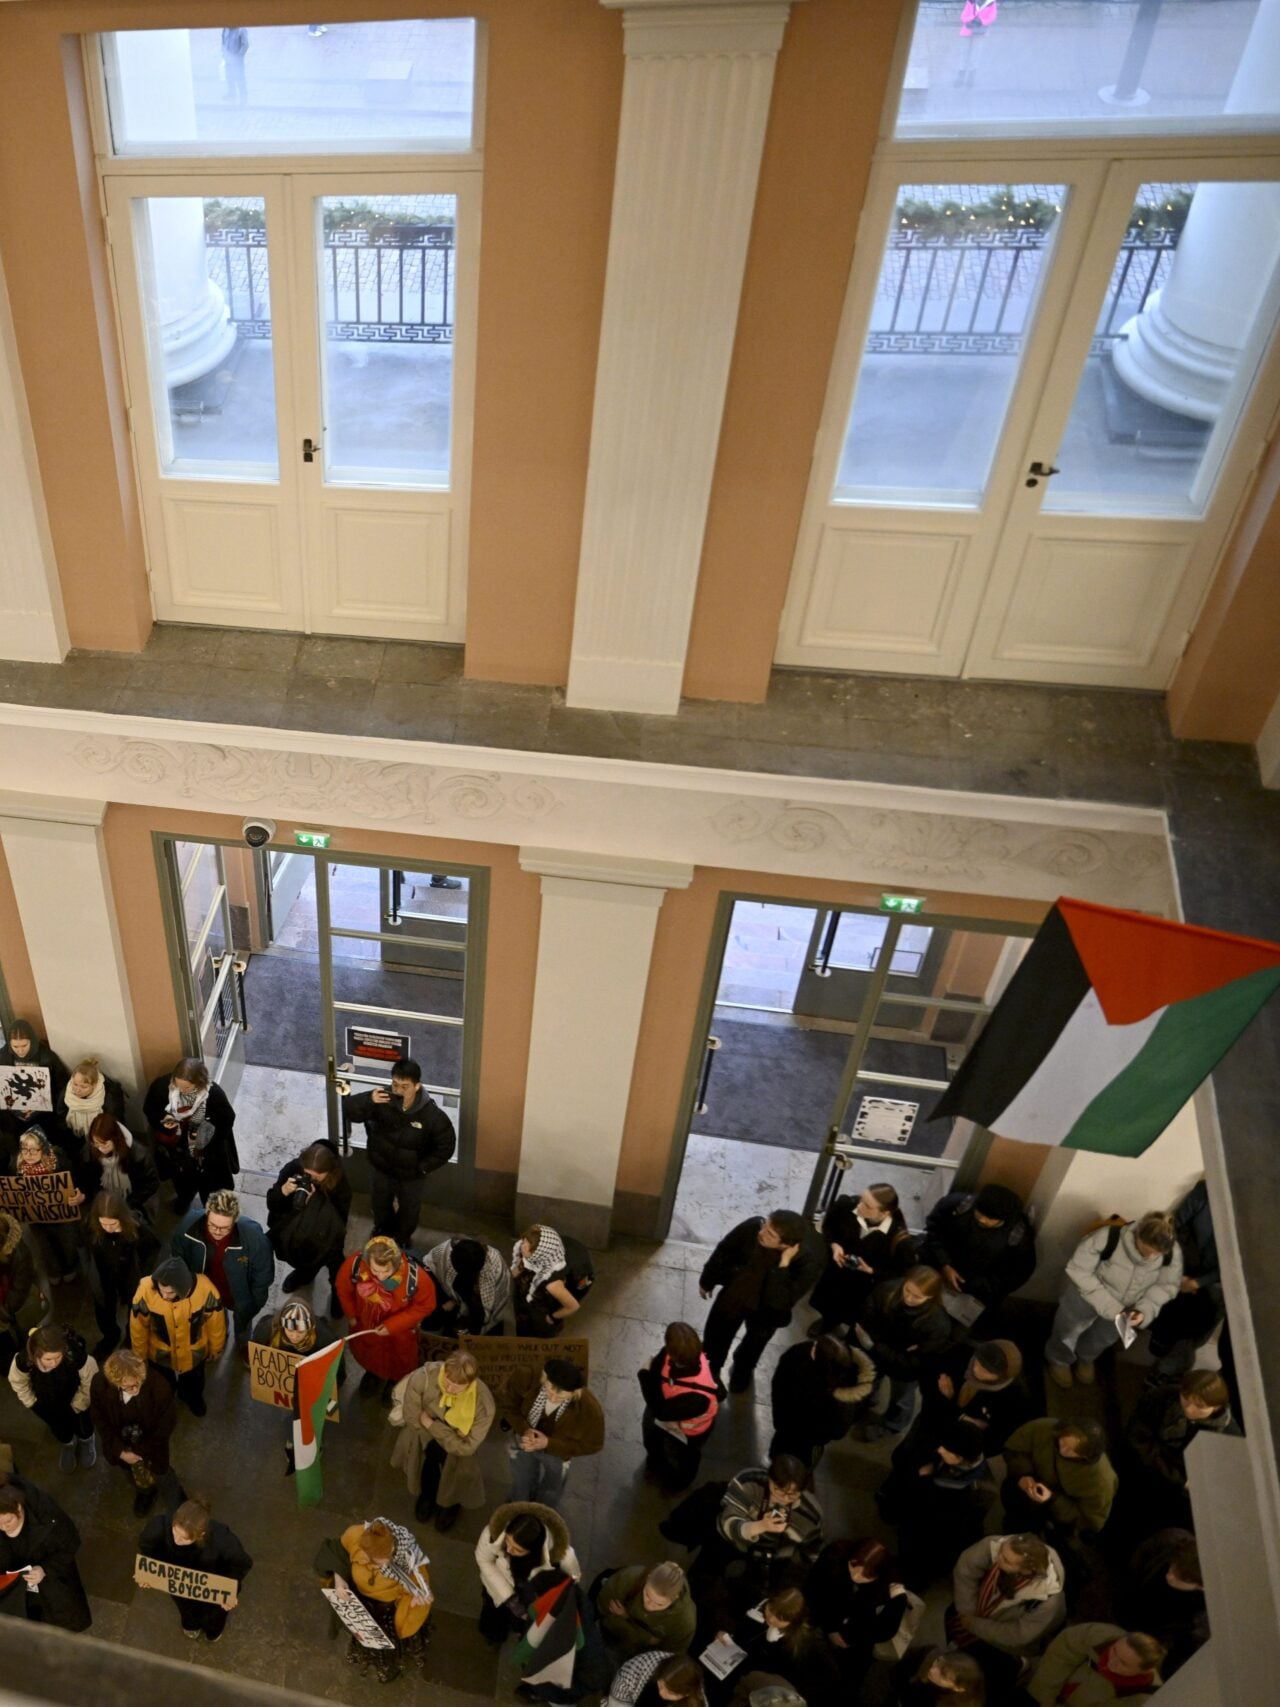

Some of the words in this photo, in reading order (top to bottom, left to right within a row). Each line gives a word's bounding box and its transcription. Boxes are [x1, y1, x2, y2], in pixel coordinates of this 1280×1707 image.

[253, 1347, 296, 1376] ACADE
[257, 1367, 295, 1393] BOYC
[138, 1557, 208, 1586] ACADEMIC
[168, 1579, 231, 1604] BOYCOTT
